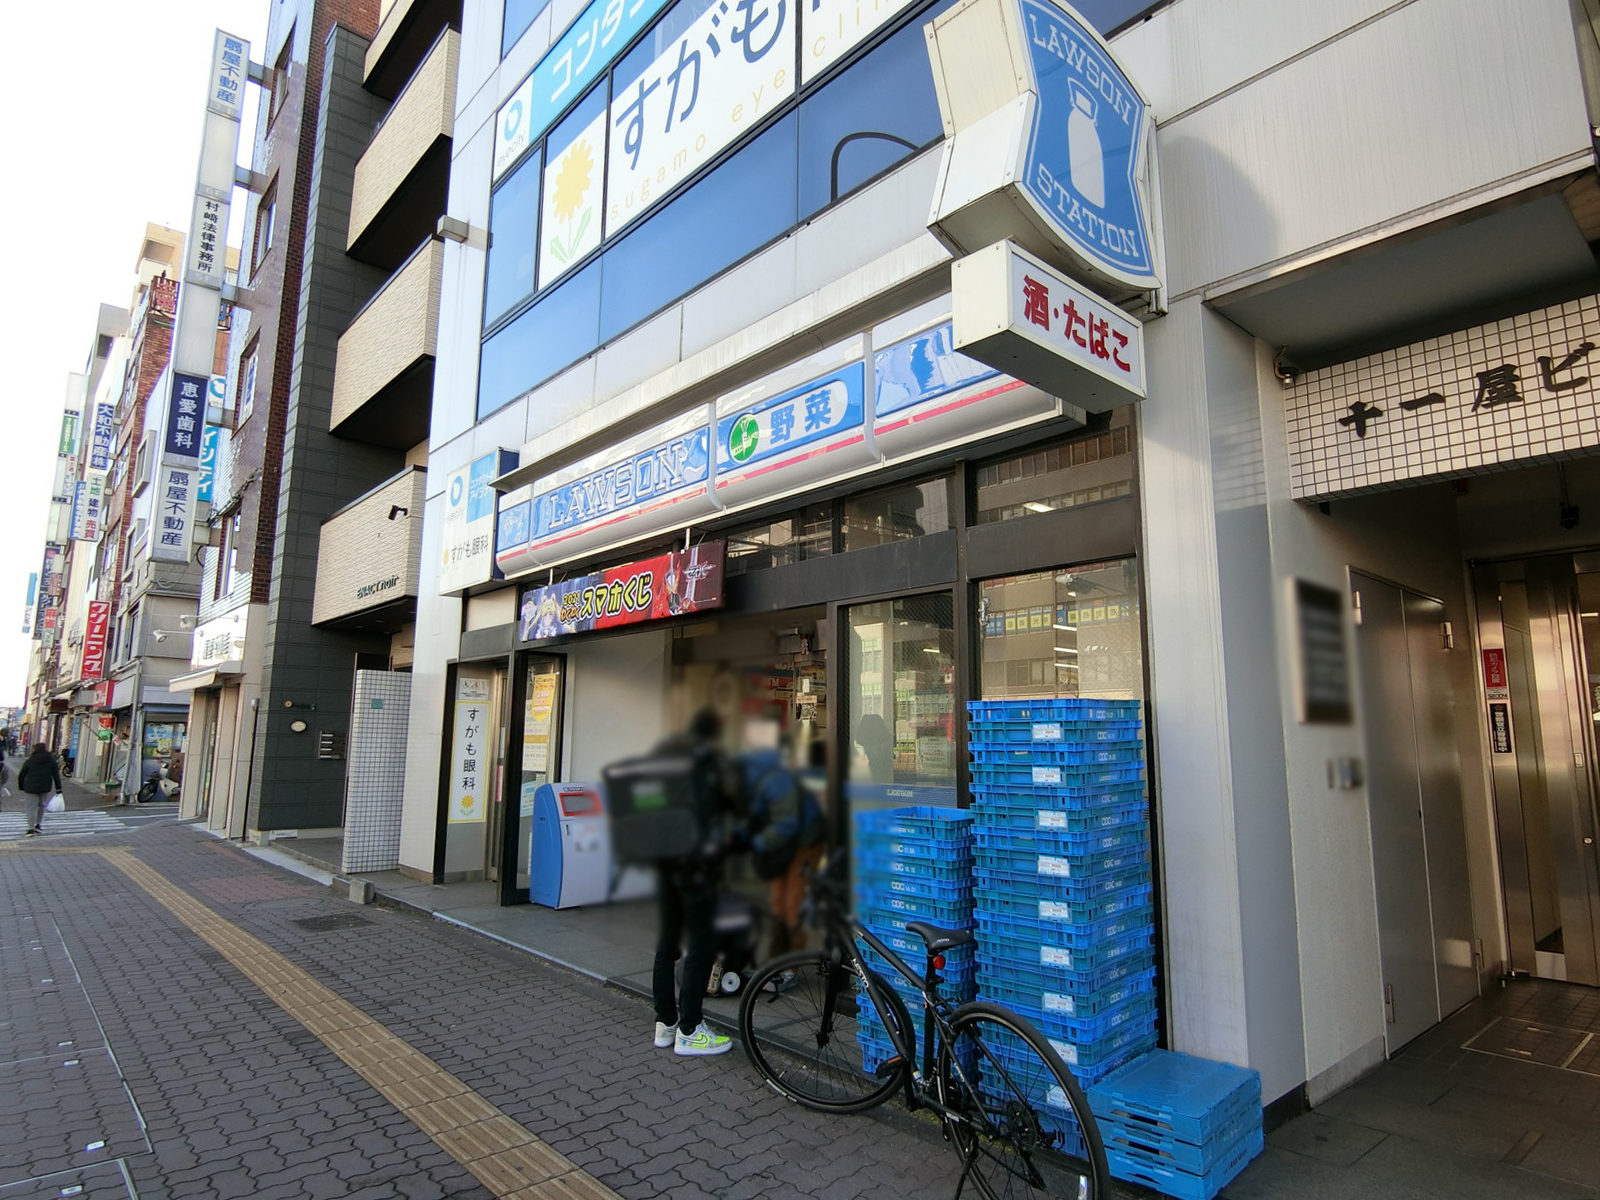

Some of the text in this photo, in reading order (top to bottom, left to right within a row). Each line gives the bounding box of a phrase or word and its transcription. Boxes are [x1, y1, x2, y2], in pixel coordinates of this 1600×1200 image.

[216, 37, 243, 105] 扇屋不動産
[551, 0, 648, 103] コンタ
[615, 0, 820, 171] すがも
[1028, 13, 1132, 127] LAWSON
[611, 134, 706, 220] sugamo
[731, 69, 786, 123] eye
[1036, 162, 1139, 258] STATION
[174, 381, 199, 449] 恵愛歯科
[769, 389, 832, 446] 野菜
[161, 470, 189, 547] 扇屋不動産
[548, 440, 687, 530] LAWSON
[451, 534, 489, 564] すがも眼科
[563, 591, 580, 606] 2021
[581, 573, 653, 619] スマホくじ
[462, 707, 480, 791] すがも眼科
